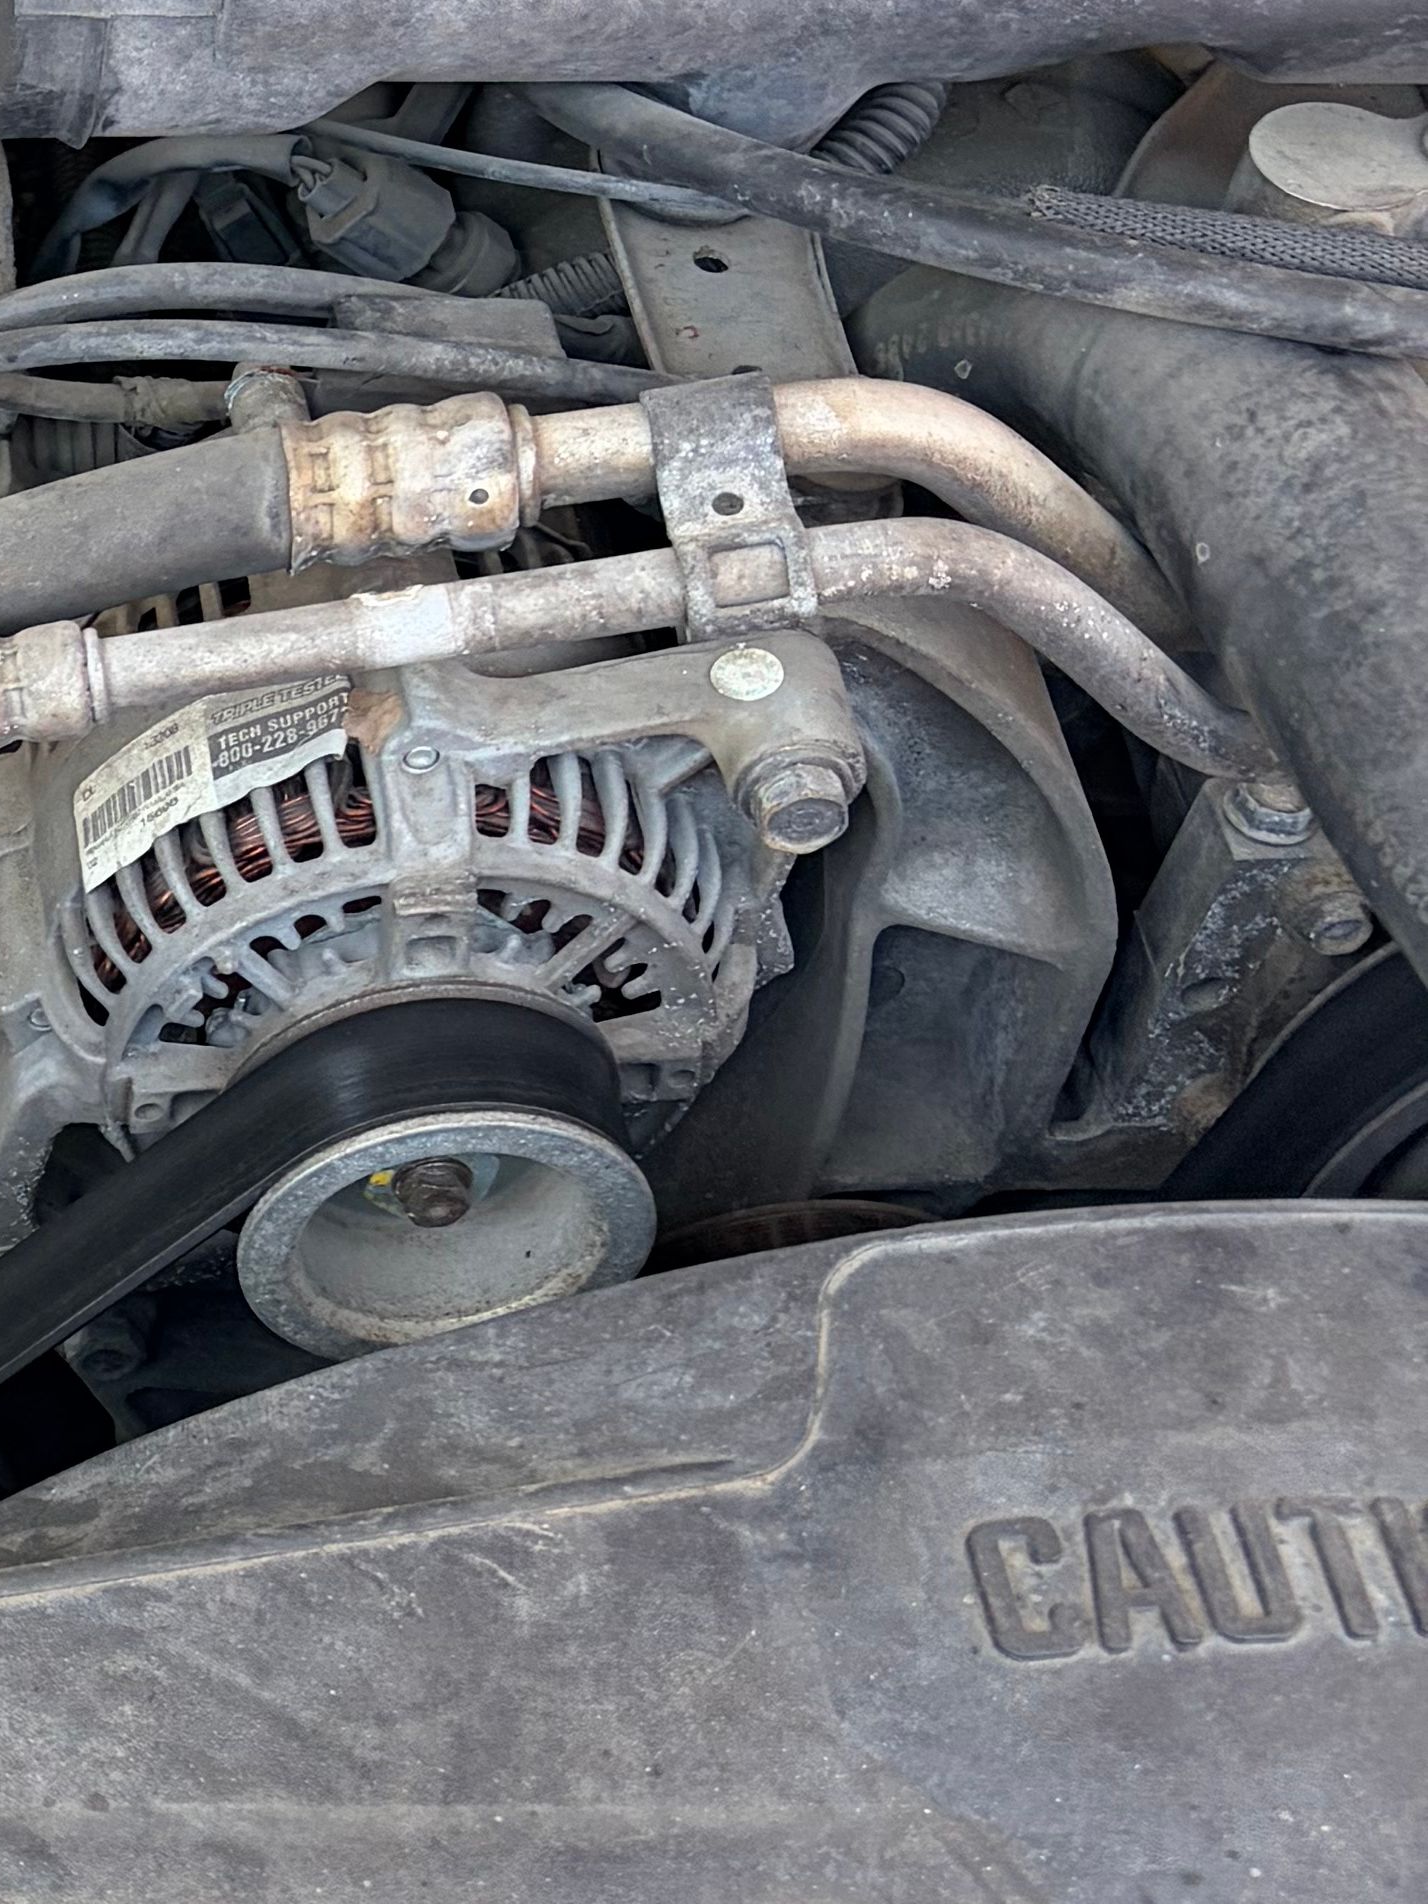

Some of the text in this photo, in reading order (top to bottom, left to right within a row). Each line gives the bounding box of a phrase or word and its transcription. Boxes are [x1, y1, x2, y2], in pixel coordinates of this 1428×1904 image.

[211, 693, 276, 725] TRIPLE
[218, 724, 262, 749] TECH
[268, 693, 350, 732] SUPPORT
[964, 1496, 1428, 1662] CAUTI
